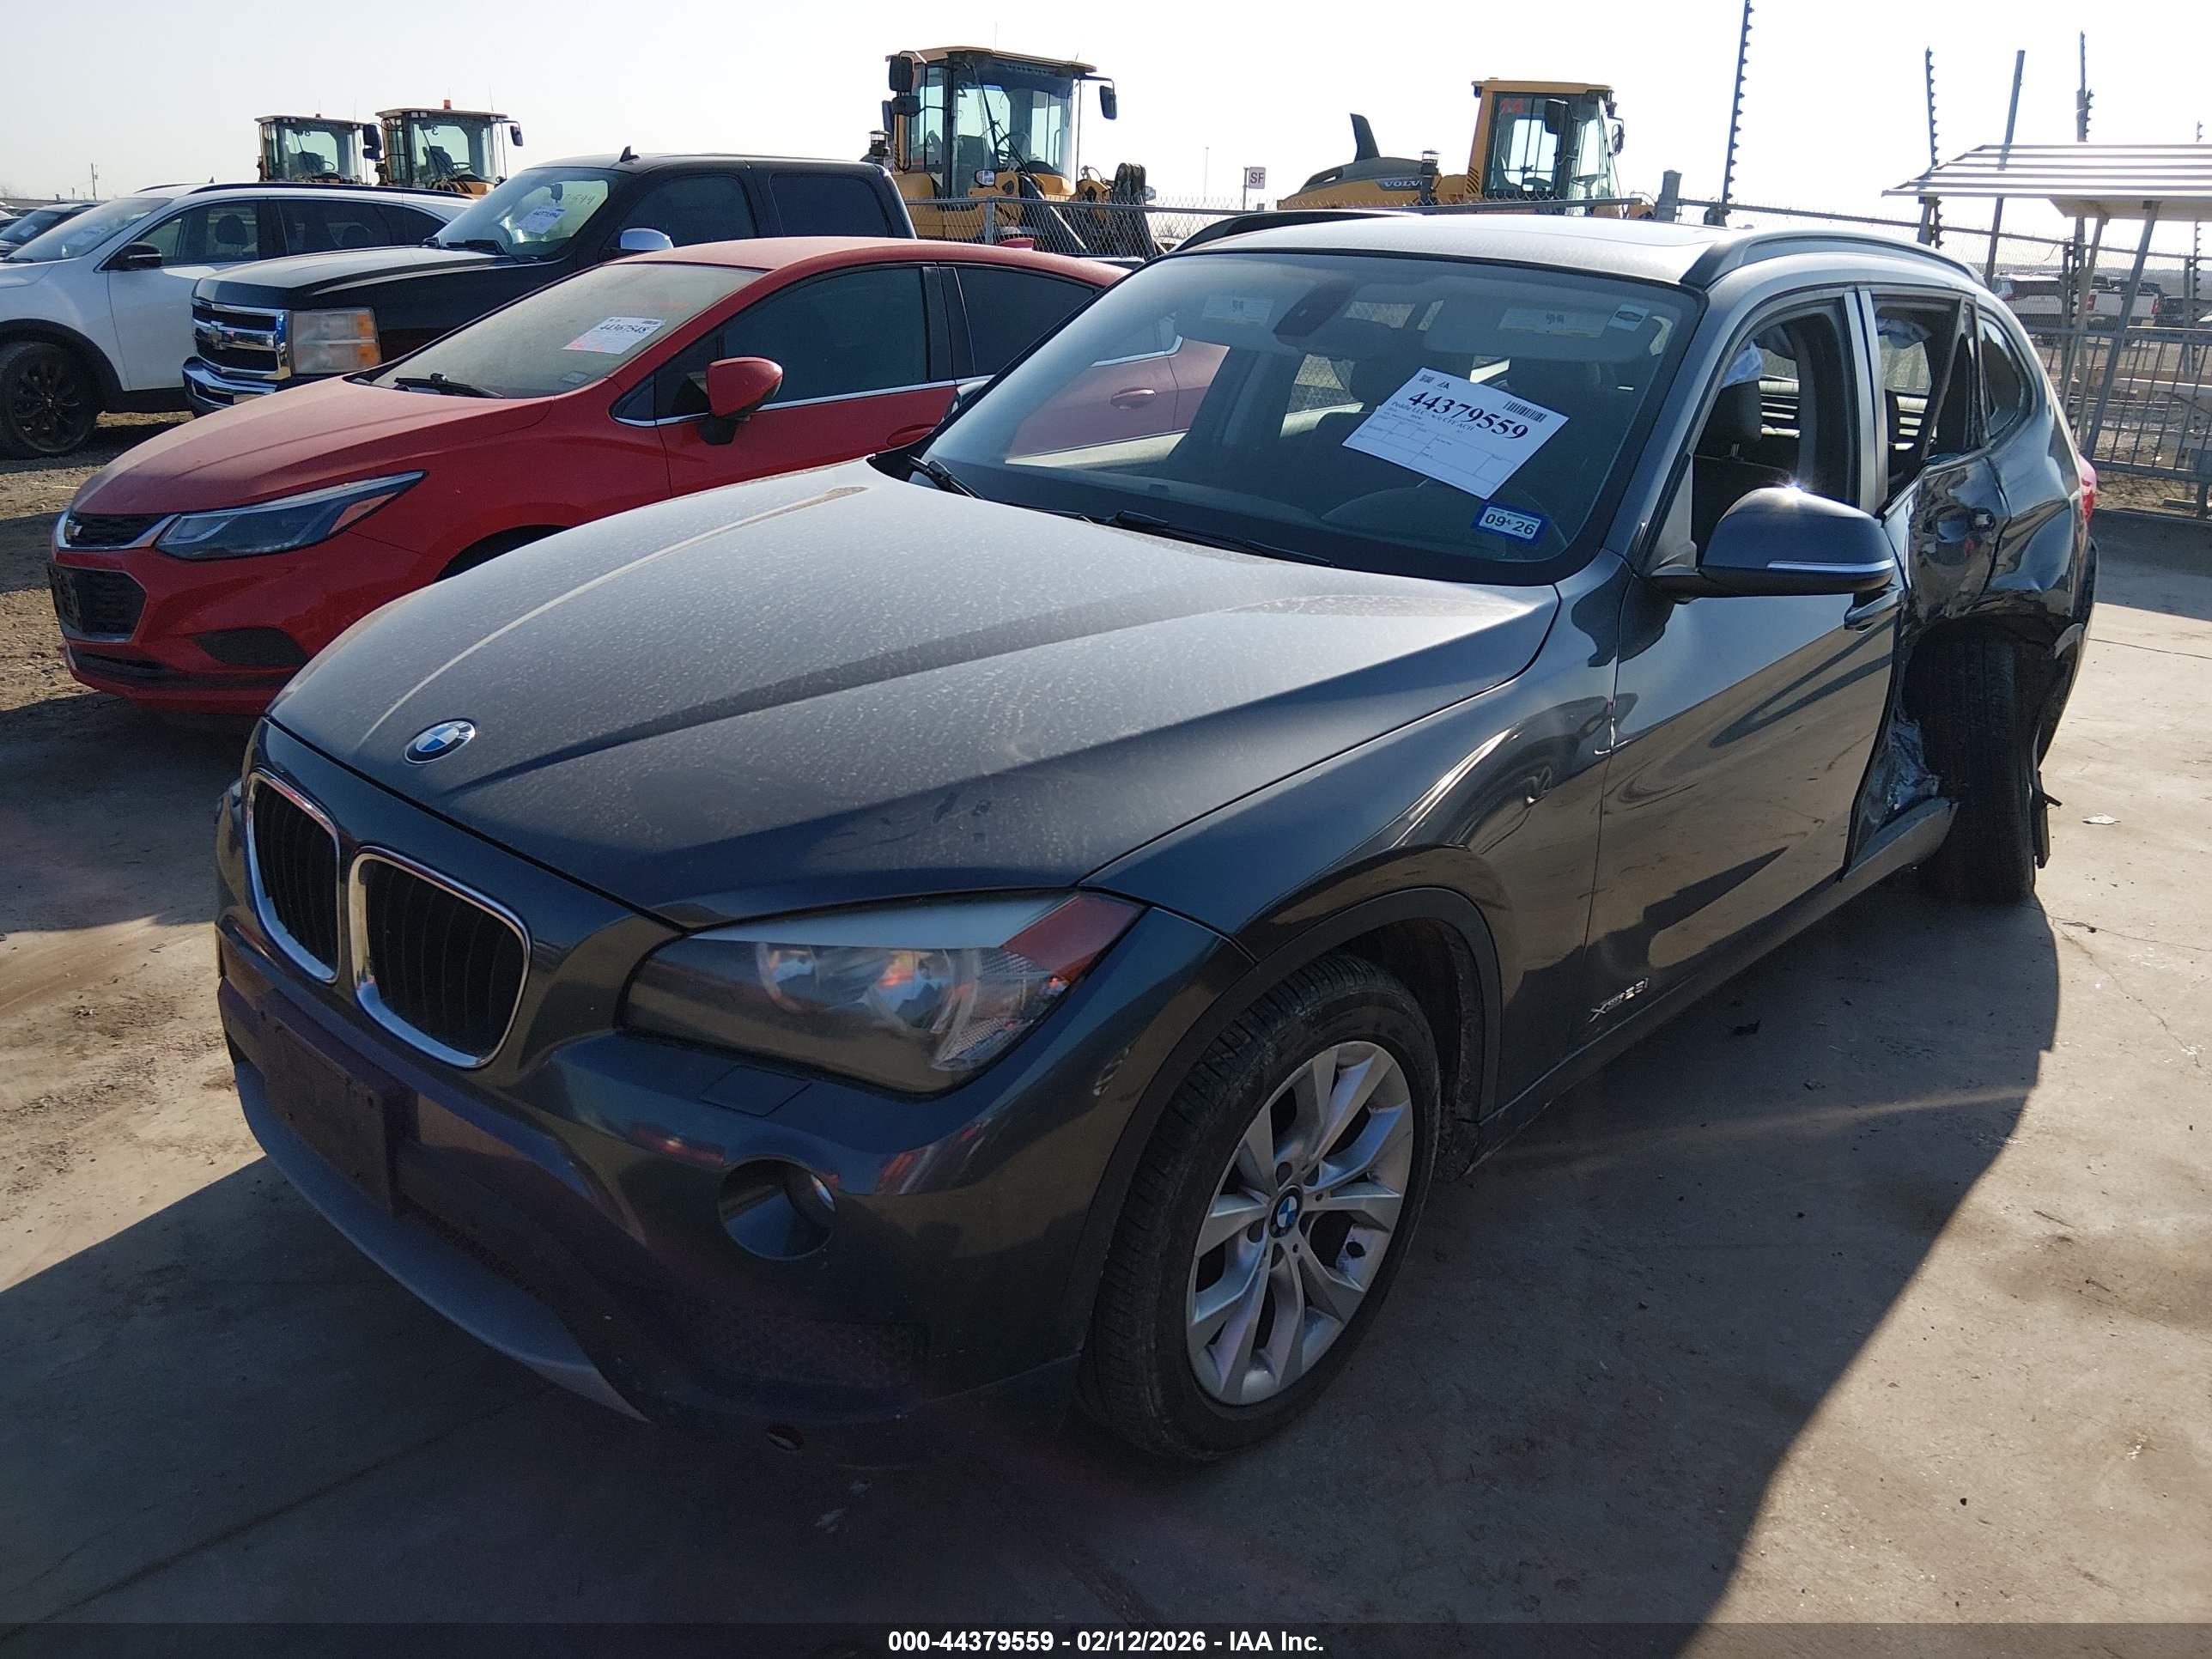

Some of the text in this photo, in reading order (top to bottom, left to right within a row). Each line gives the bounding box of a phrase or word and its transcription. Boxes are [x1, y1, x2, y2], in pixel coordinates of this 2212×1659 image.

[1249, 172, 1265, 184] SF
[1383, 179, 1423, 187] VOLV
[1407, 391, 1528, 439] 44379559
[1485, 514, 1506, 526] 09
[1512, 520, 1535, 535] 26
